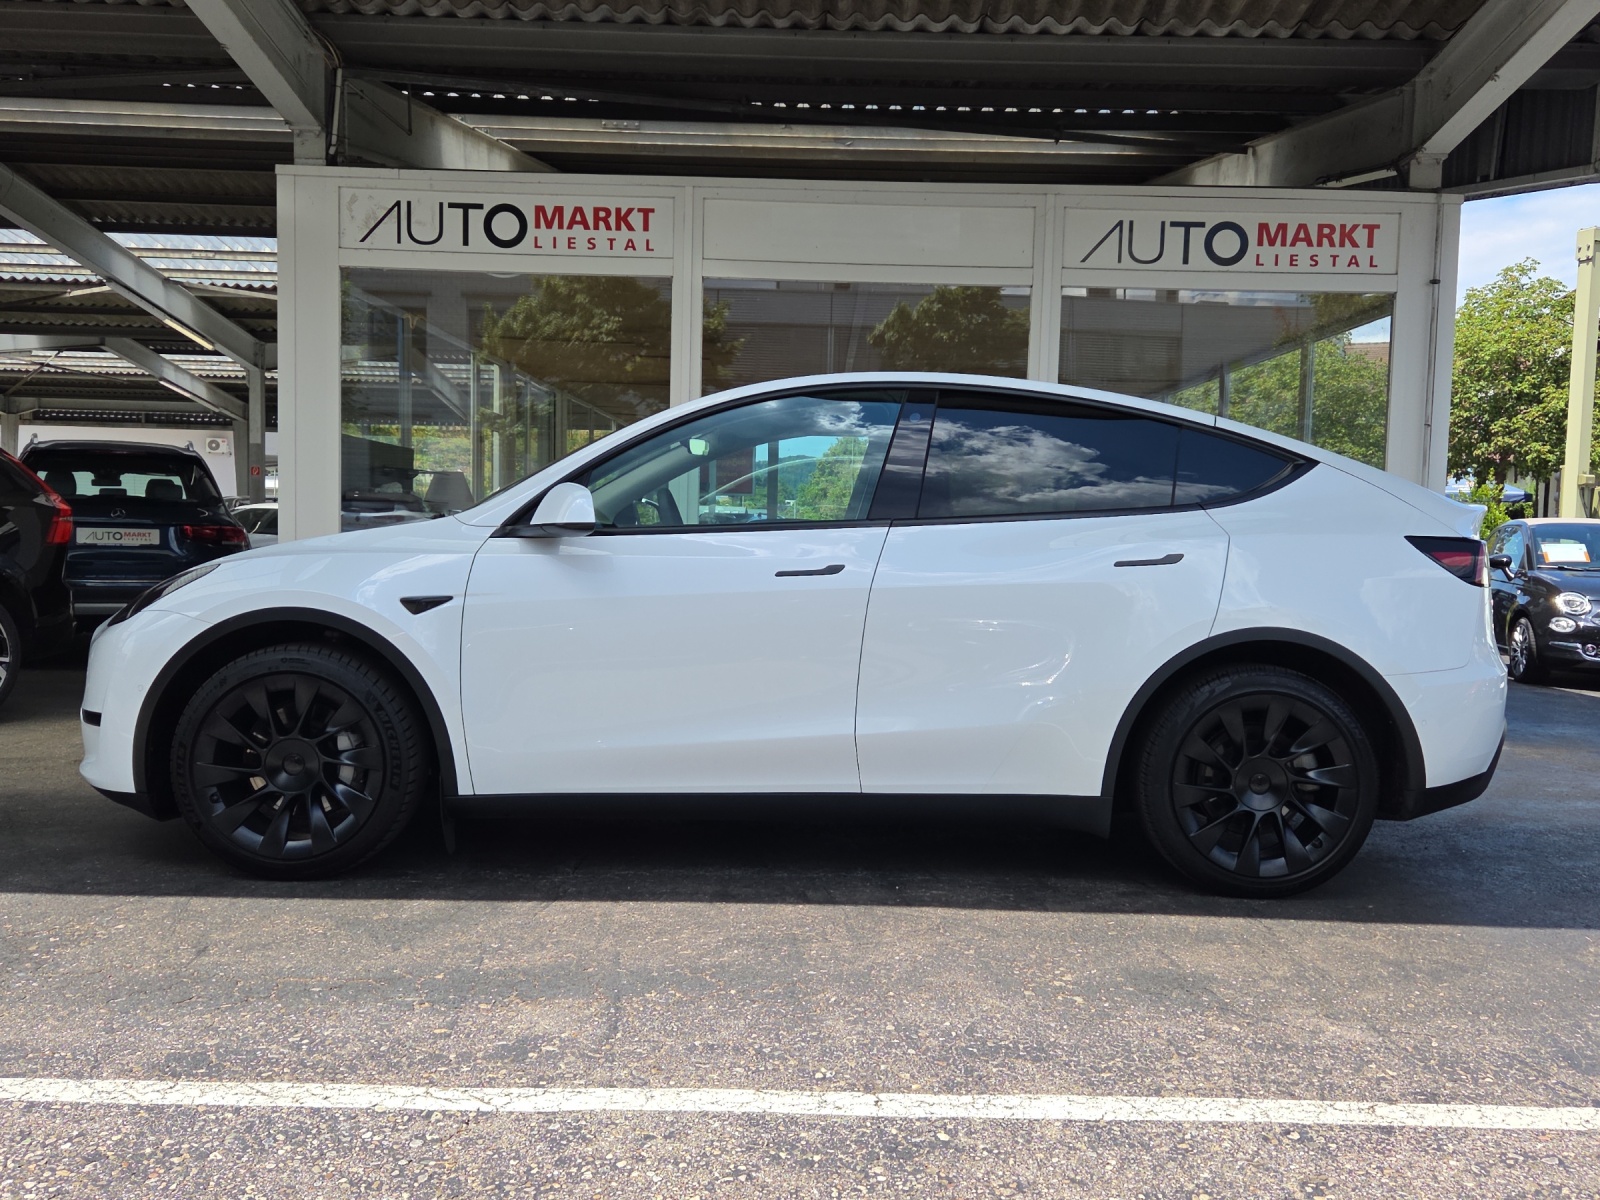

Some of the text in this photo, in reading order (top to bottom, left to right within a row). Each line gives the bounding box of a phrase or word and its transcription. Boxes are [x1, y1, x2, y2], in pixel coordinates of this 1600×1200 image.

[359, 199, 656, 249] AUTO MARKT
[533, 236, 655, 252] LIESTAL
[1080, 219, 1381, 267] AUTO MARKT
[1255, 253, 1379, 268] LIESTAL
[85, 531, 123, 541] AUTO
[378, 708, 402, 788] MICHELIN
